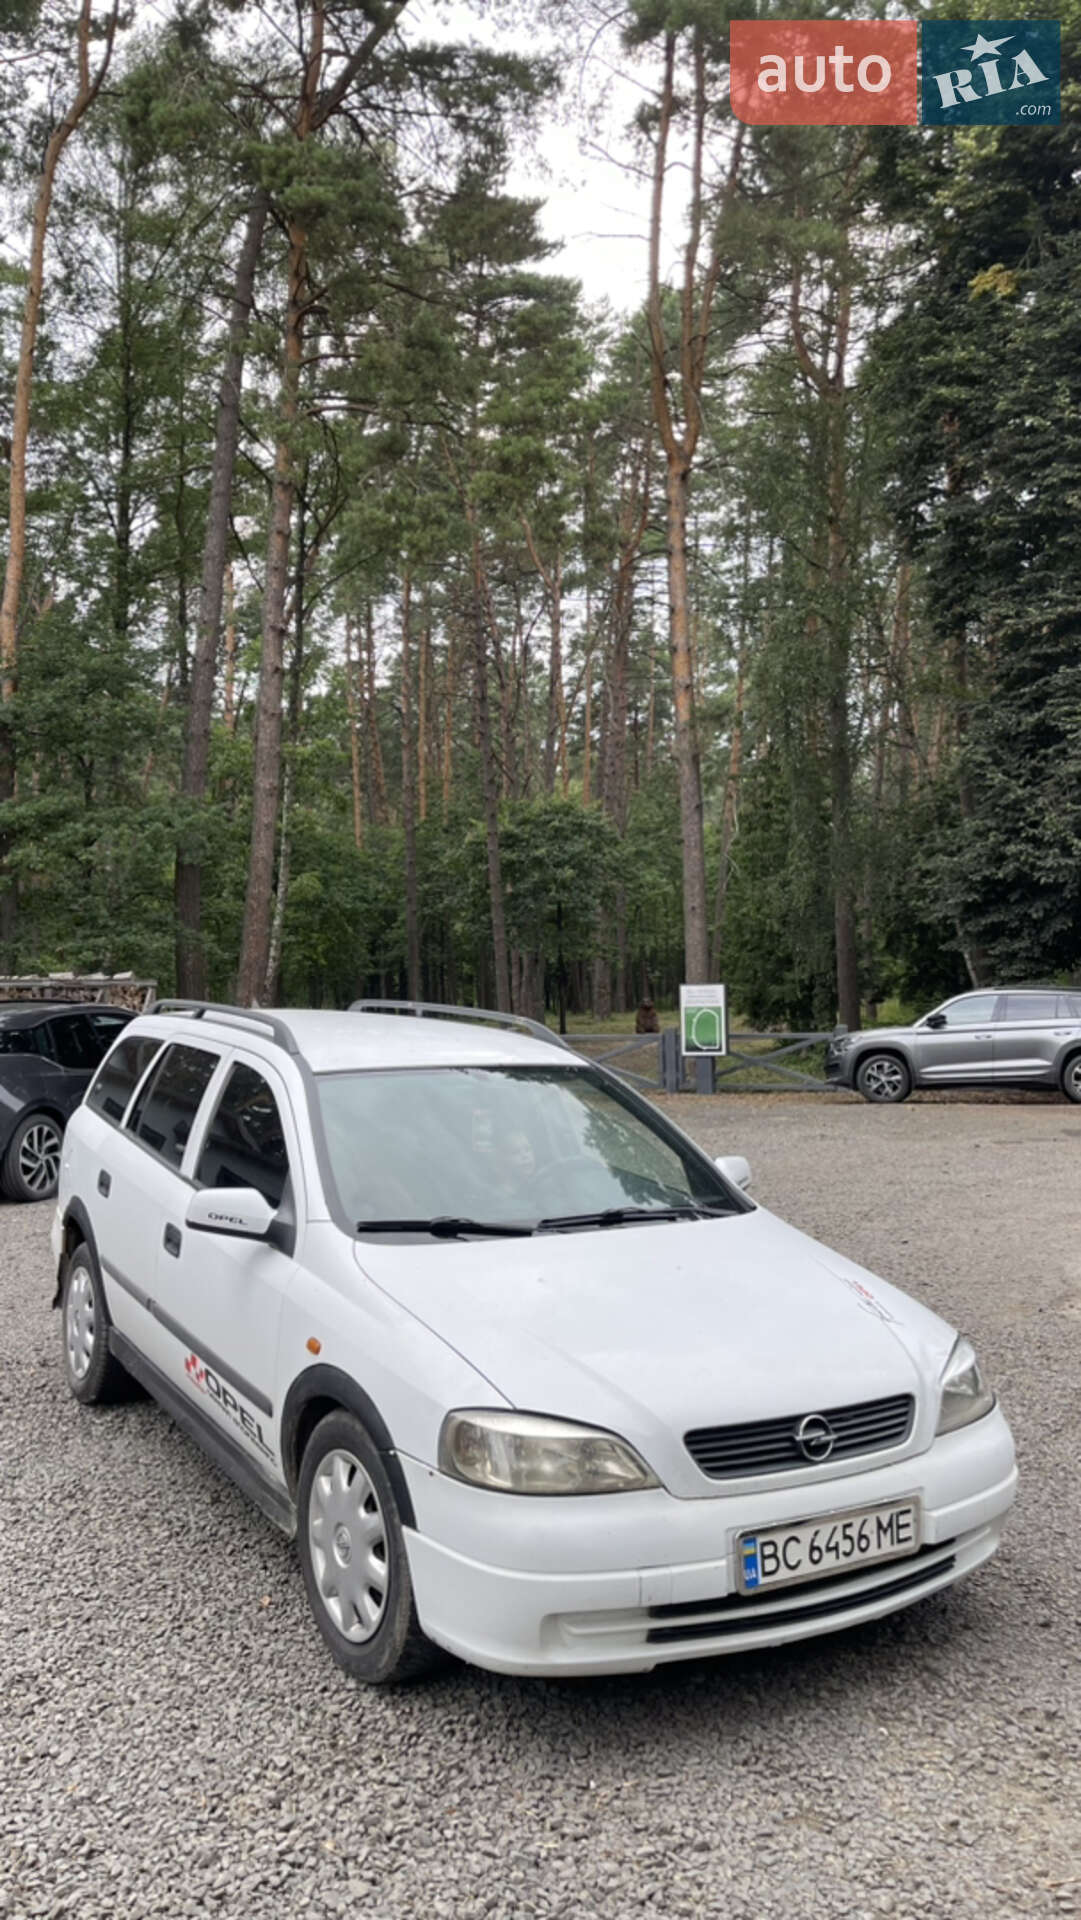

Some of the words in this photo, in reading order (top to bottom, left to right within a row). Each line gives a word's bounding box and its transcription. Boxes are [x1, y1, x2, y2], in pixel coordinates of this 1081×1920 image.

[207, 1212, 248, 1226] OPEL
[205, 1367, 275, 1457] OPEL
[760, 1536, 802, 1577] BC
[808, 1518, 870, 1565] 6456
[876, 1508, 912, 1549] ME
